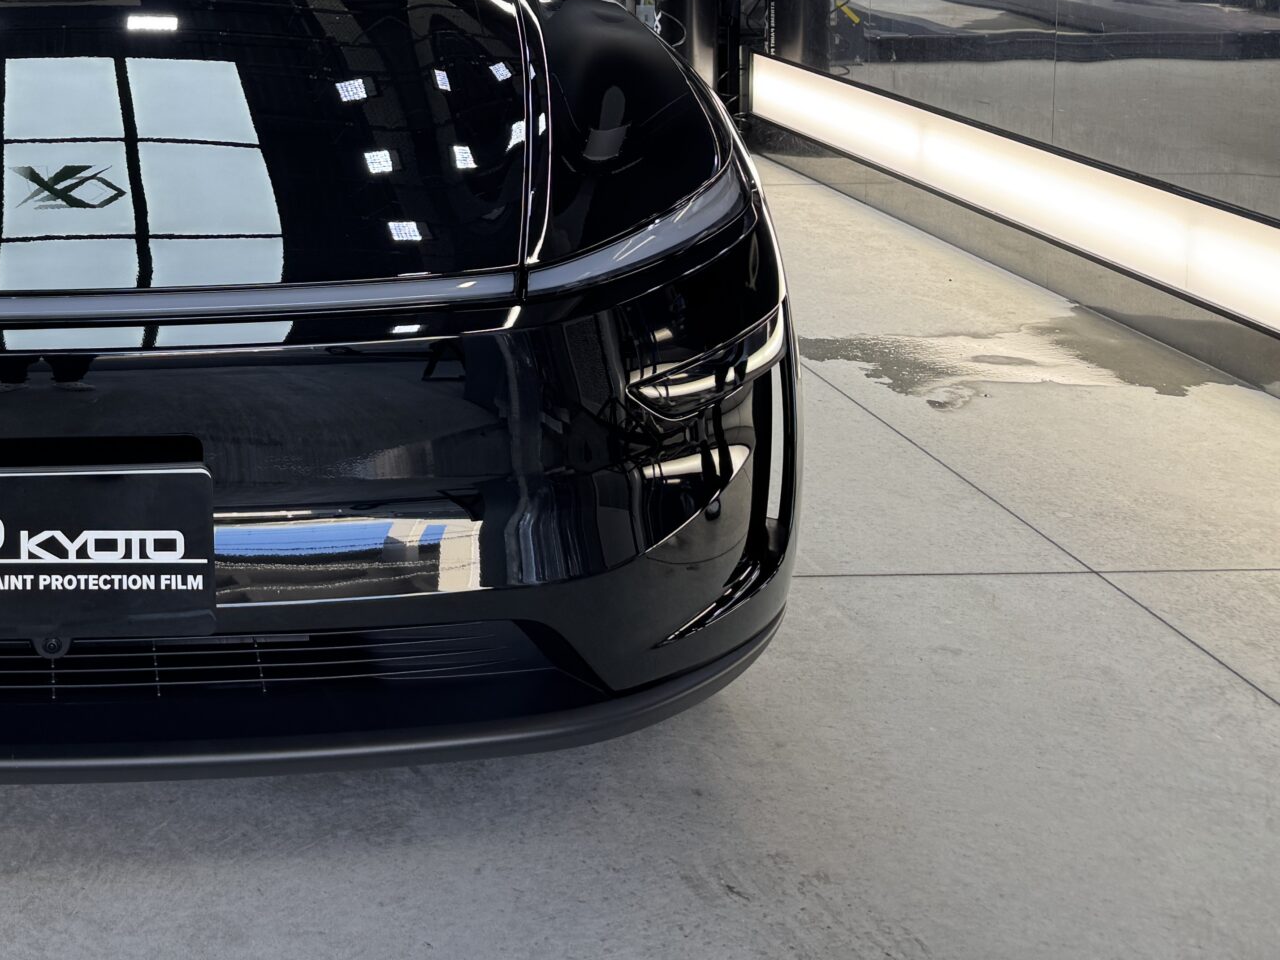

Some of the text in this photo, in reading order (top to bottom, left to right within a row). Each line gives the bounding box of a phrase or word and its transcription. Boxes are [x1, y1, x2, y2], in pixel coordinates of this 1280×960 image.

[20, 530, 185, 560] KYOTO
[38, 575, 156, 590] PROTECTION
[160, 575, 204, 590] FILM
